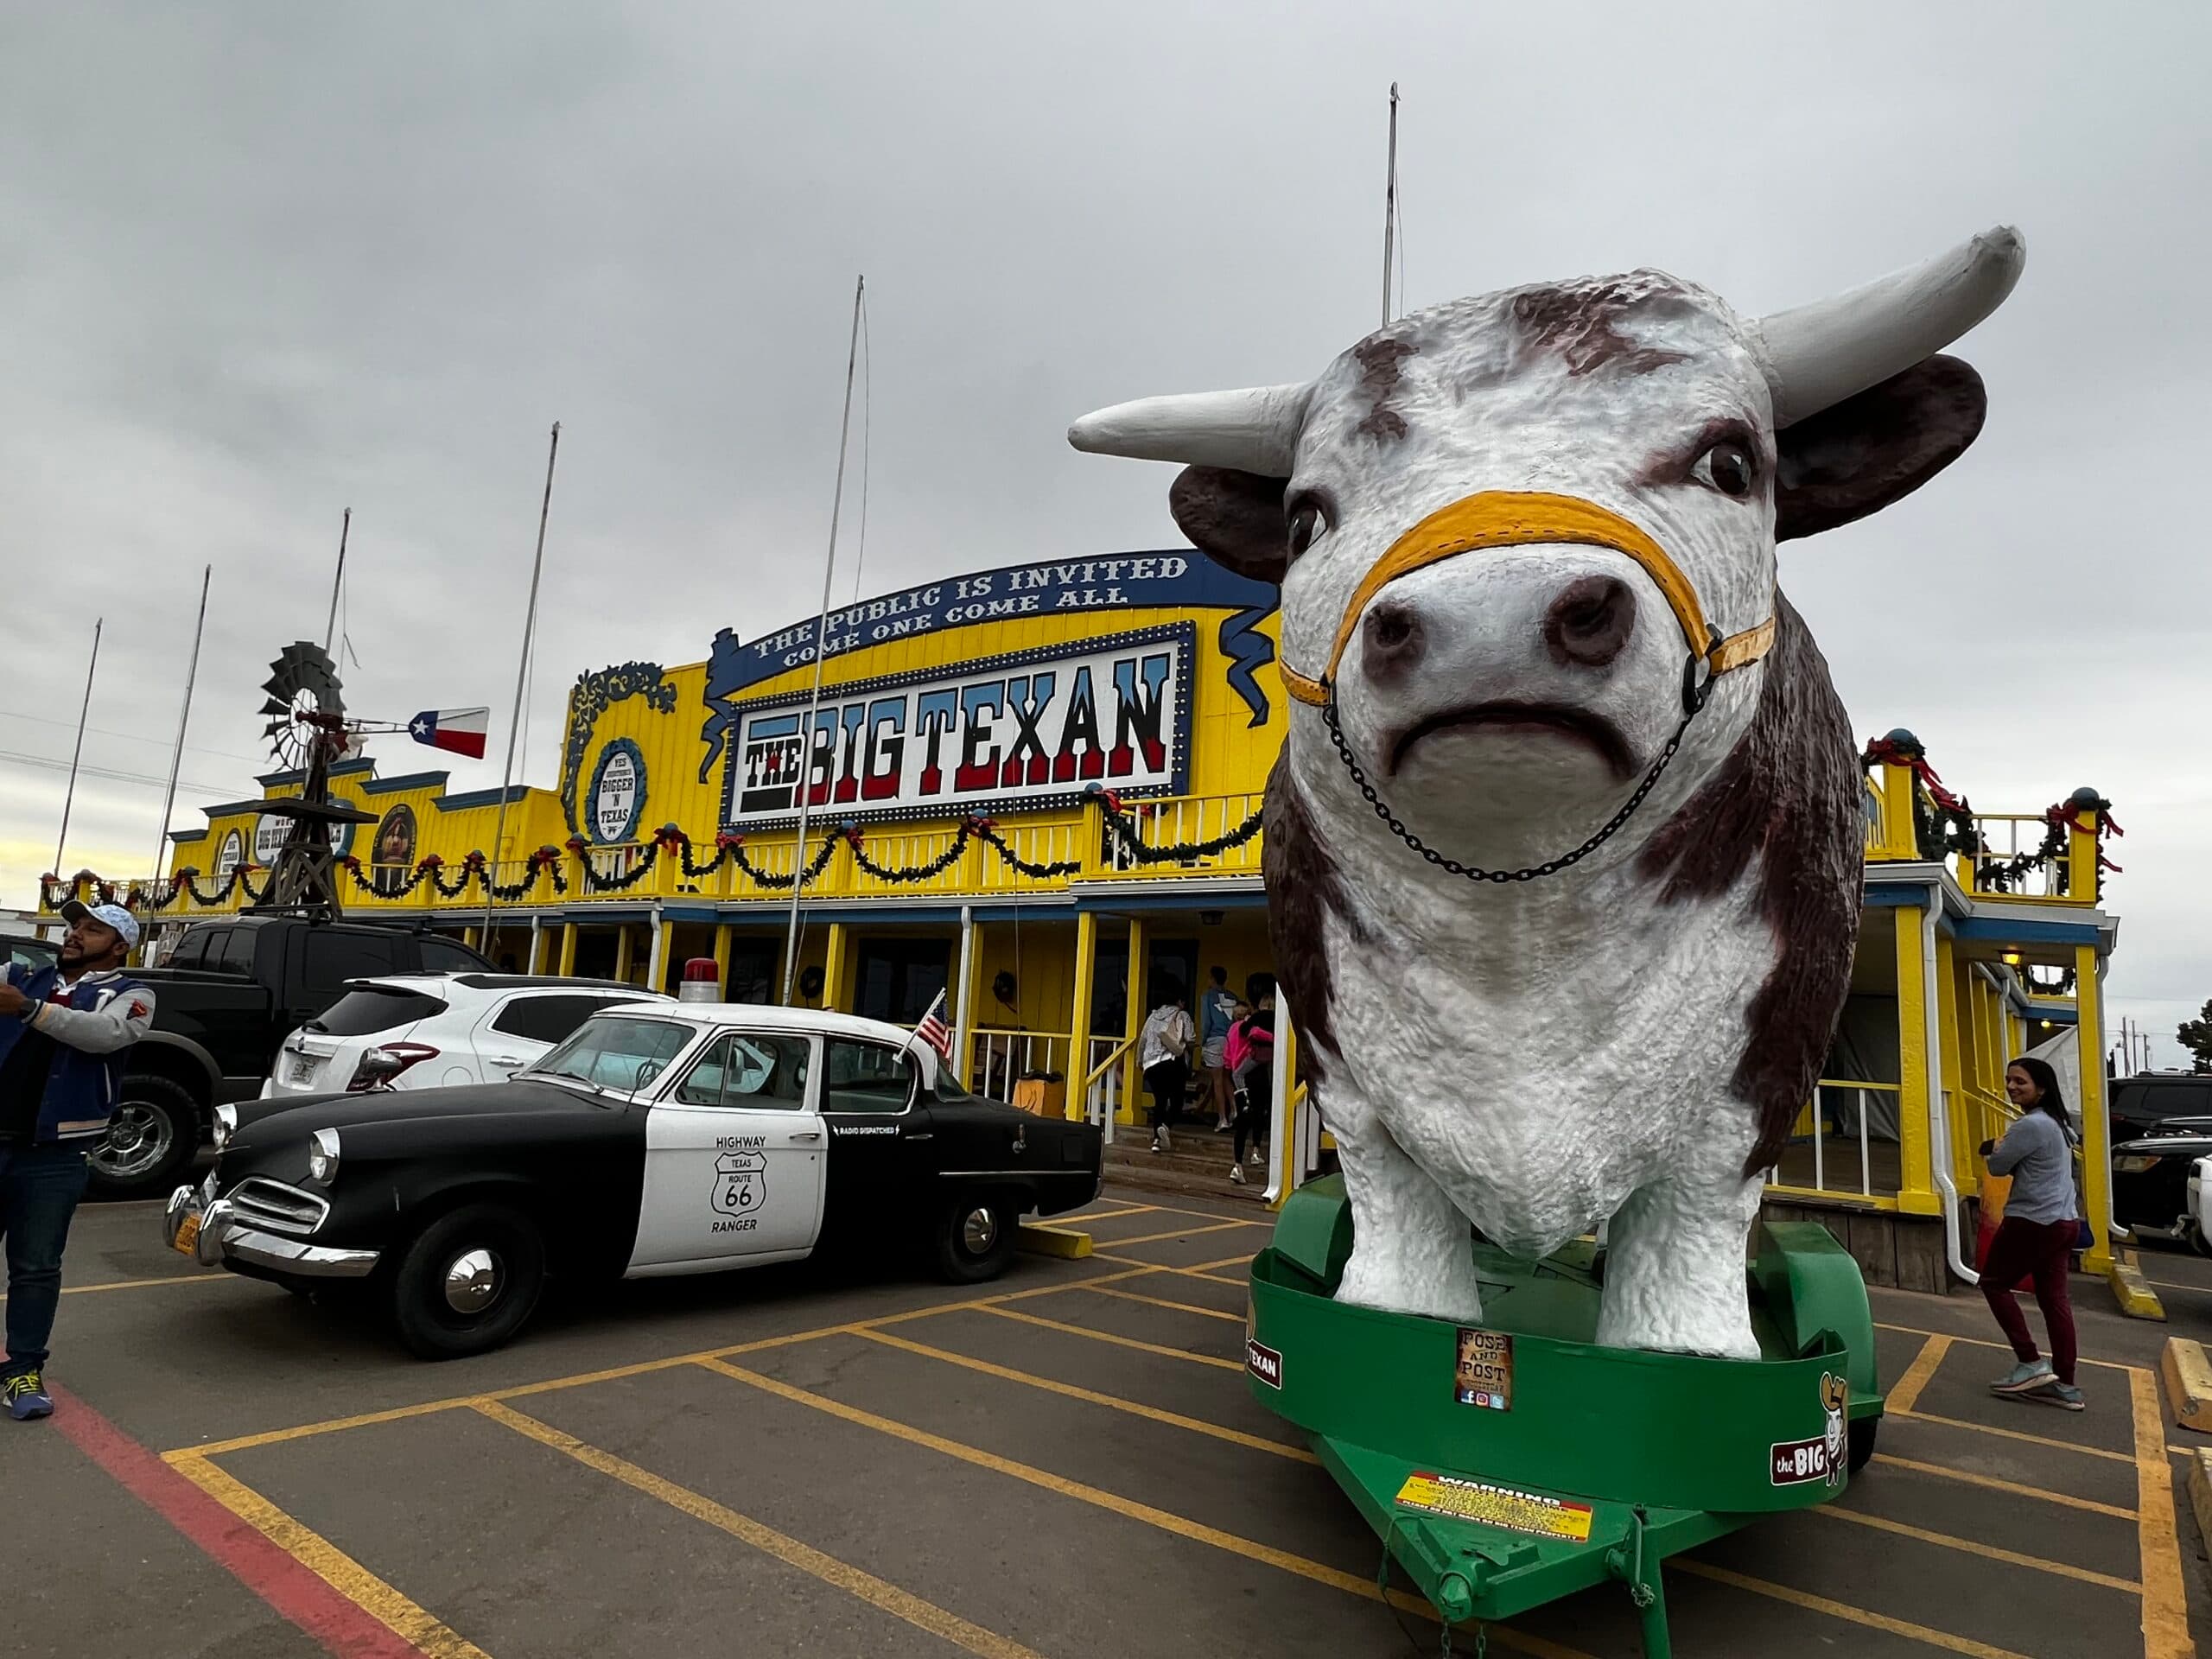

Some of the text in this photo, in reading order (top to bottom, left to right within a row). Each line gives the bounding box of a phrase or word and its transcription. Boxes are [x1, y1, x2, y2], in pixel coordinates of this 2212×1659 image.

[754, 557, 1188, 658] THE PUBLIC IS INVITED
[784, 588, 1128, 666] COME ONE COME ALL
[745, 652, 1171, 808] THE BIG TEXAN
[614, 758, 626, 767] YES
[601, 778, 633, 793] BIGGER
[601, 808, 629, 823] TEXAS
[715, 1136, 766, 1148] HIGHWAY
[731, 1159, 752, 1168] TEXAS
[728, 1174, 752, 1183] ROUTE
[725, 1184, 752, 1207] 66
[711, 1218, 758, 1233] RANGER
[1462, 1332, 1506, 1351] POSE
[1249, 1346, 1276, 1377] TEXAN
[1470, 1351, 1498, 1361] AND
[1461, 1361, 1505, 1382] POST
[1777, 1444, 1824, 1476] the BIG
[1438, 1476, 1560, 1504] WARNING
